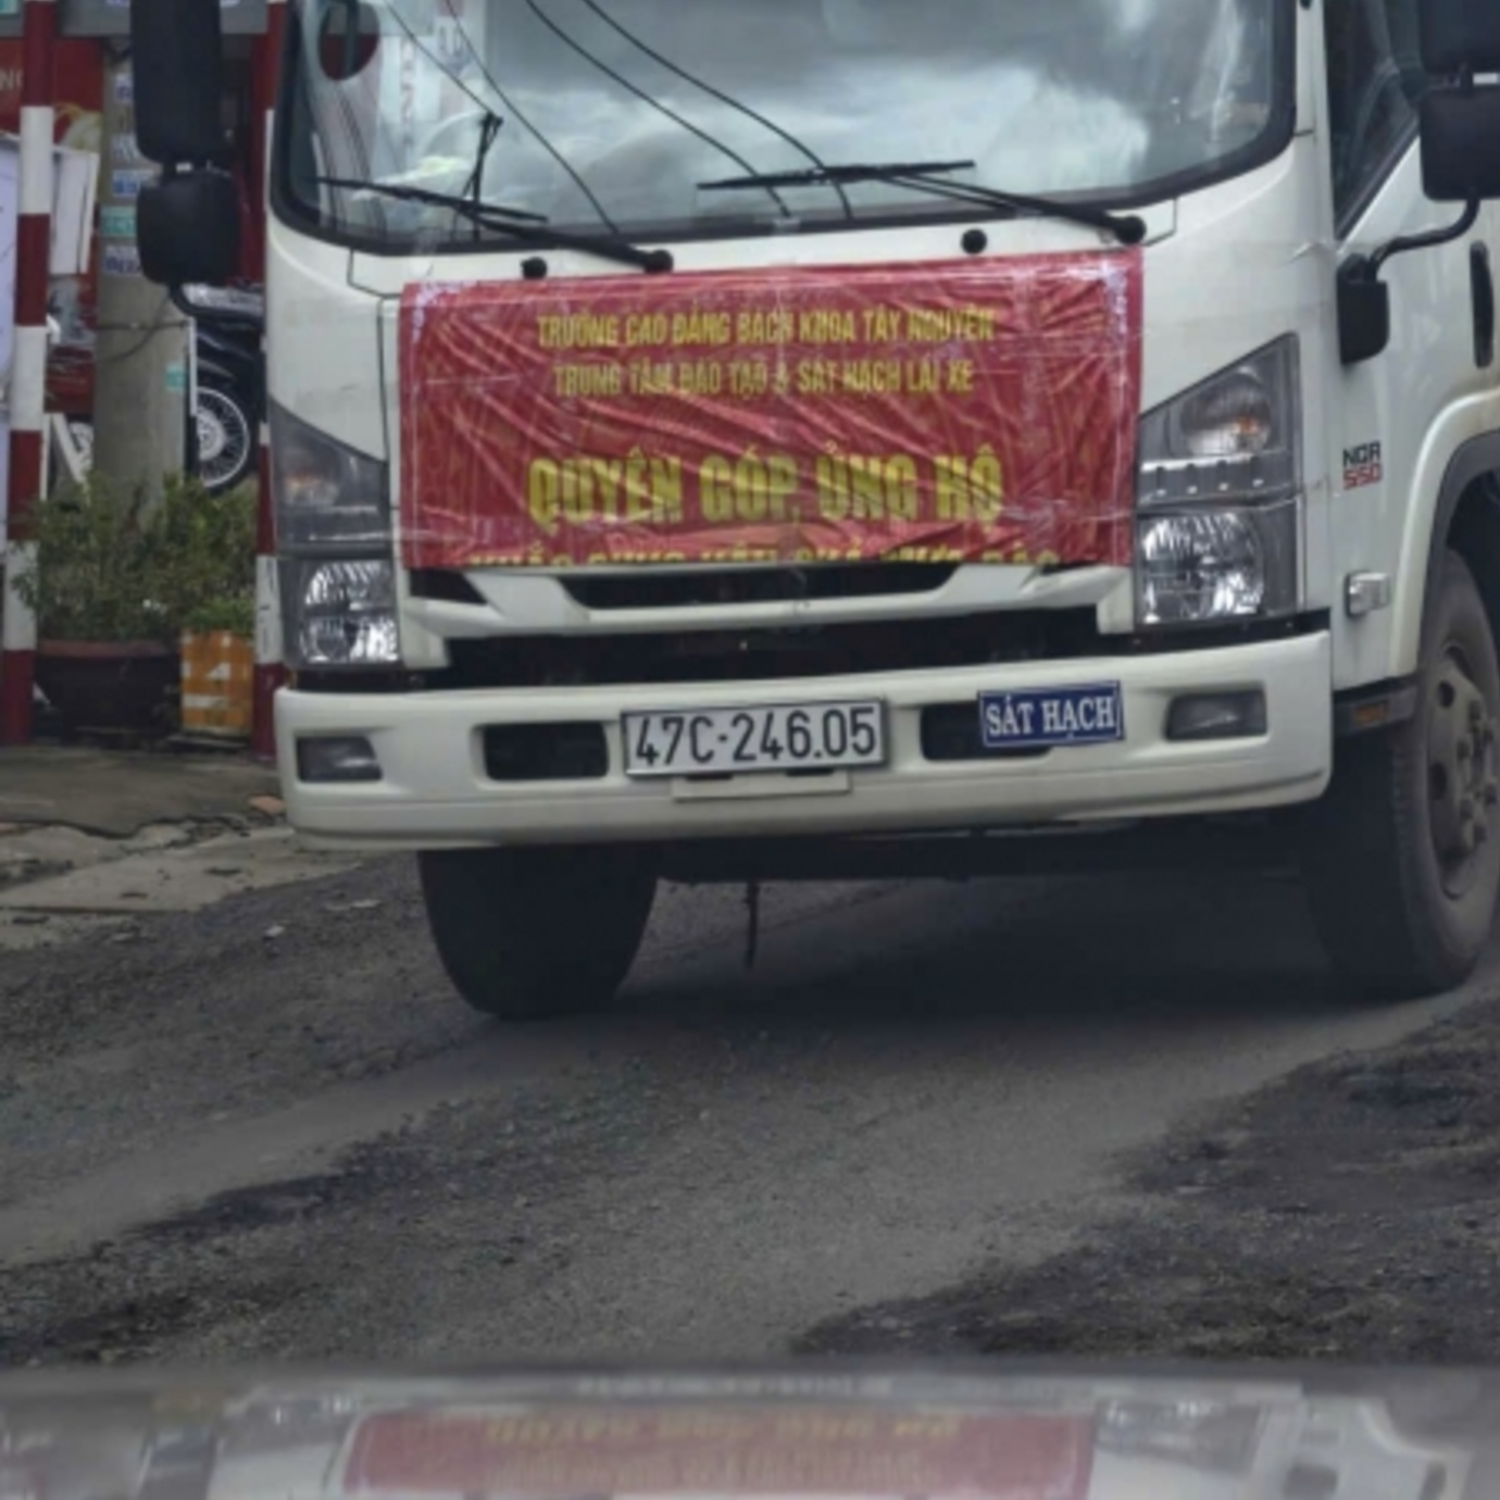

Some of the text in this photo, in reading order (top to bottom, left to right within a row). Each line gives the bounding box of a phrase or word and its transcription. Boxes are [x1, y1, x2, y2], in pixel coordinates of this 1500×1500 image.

[537, 311, 619, 349] TRƯỜNG
[625, 312, 668, 345] CAO
[799, 309, 856, 343] KHOA
[862, 303, 901, 342] TÂY
[553, 362, 622, 397] TRUNG
[945, 358, 975, 391] XE
[528, 446, 684, 536] QUYÊN
[815, 440, 918, 523] ỦNG
[933, 444, 1004, 534] HỘ
[634, 707, 878, 766] 47C-246.05
[985, 696, 1117, 738] SÁT HẠCH
